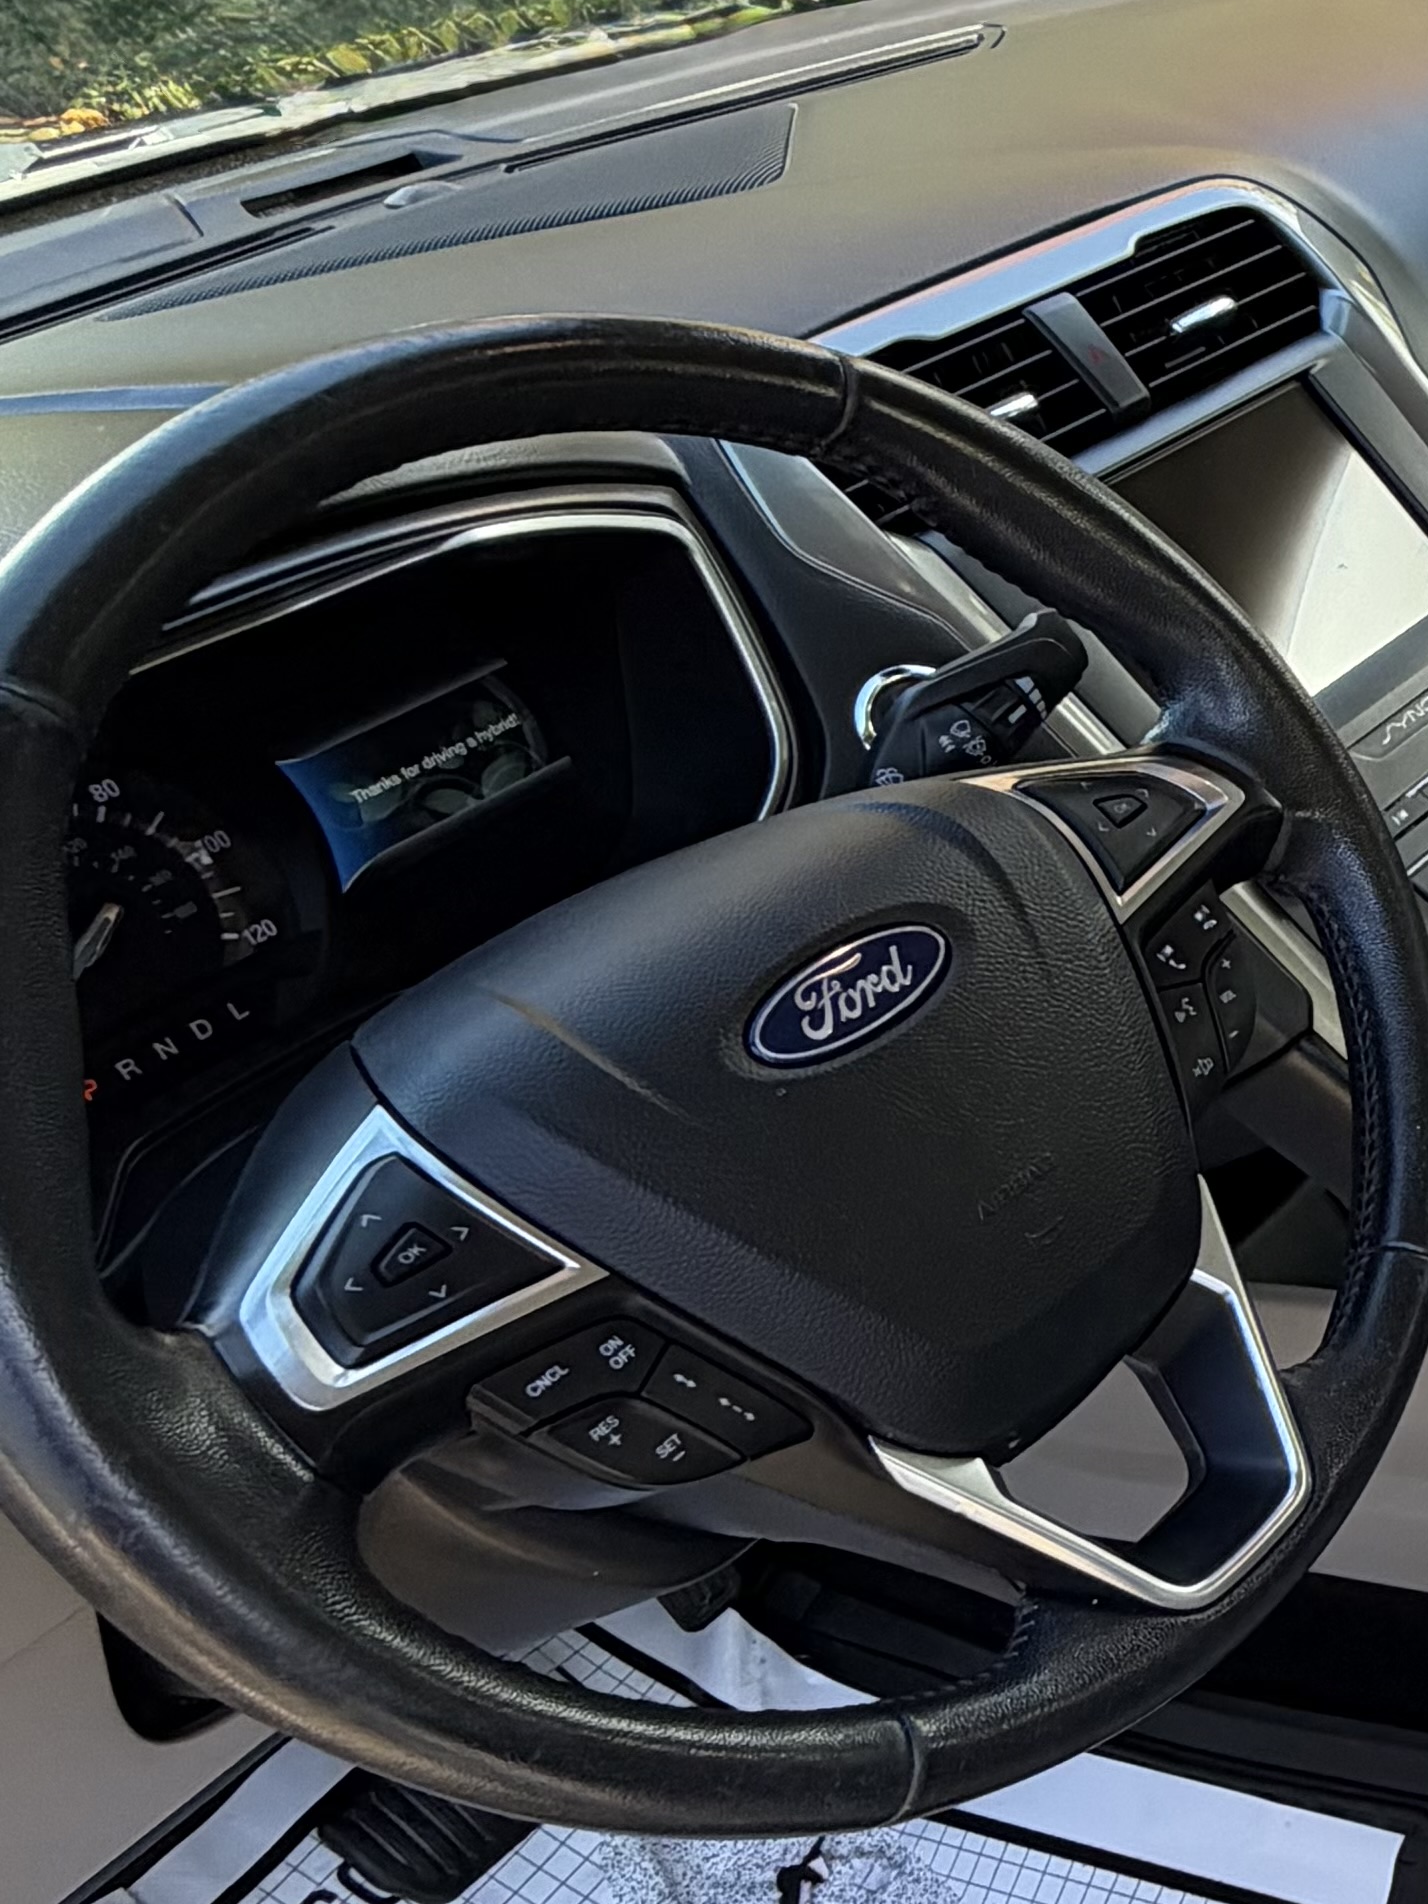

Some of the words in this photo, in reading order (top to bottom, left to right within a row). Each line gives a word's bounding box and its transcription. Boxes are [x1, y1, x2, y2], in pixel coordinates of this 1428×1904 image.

[350, 774, 402, 803] Thanks
[400, 764, 421, 781] for
[421, 742, 468, 771] driving
[466, 737, 478, 749] a
[88, 778, 120, 803] 80
[241, 919, 278, 945] 120
[794, 944, 913, 1041] Ford
[114, 1058, 143, 1081] R
[152, 1037, 180, 1061] N
[188, 1018, 214, 1041] D
[226, 1002, 251, 1021] L
[397, 1243, 427, 1264] OK
[599, 1335, 624, 1357] ON
[608, 1344, 636, 1370] OFF
[525, 1364, 570, 1397] CNCL
[588, 1415, 620, 1442] RES
[655, 1433, 682, 1459] SET
